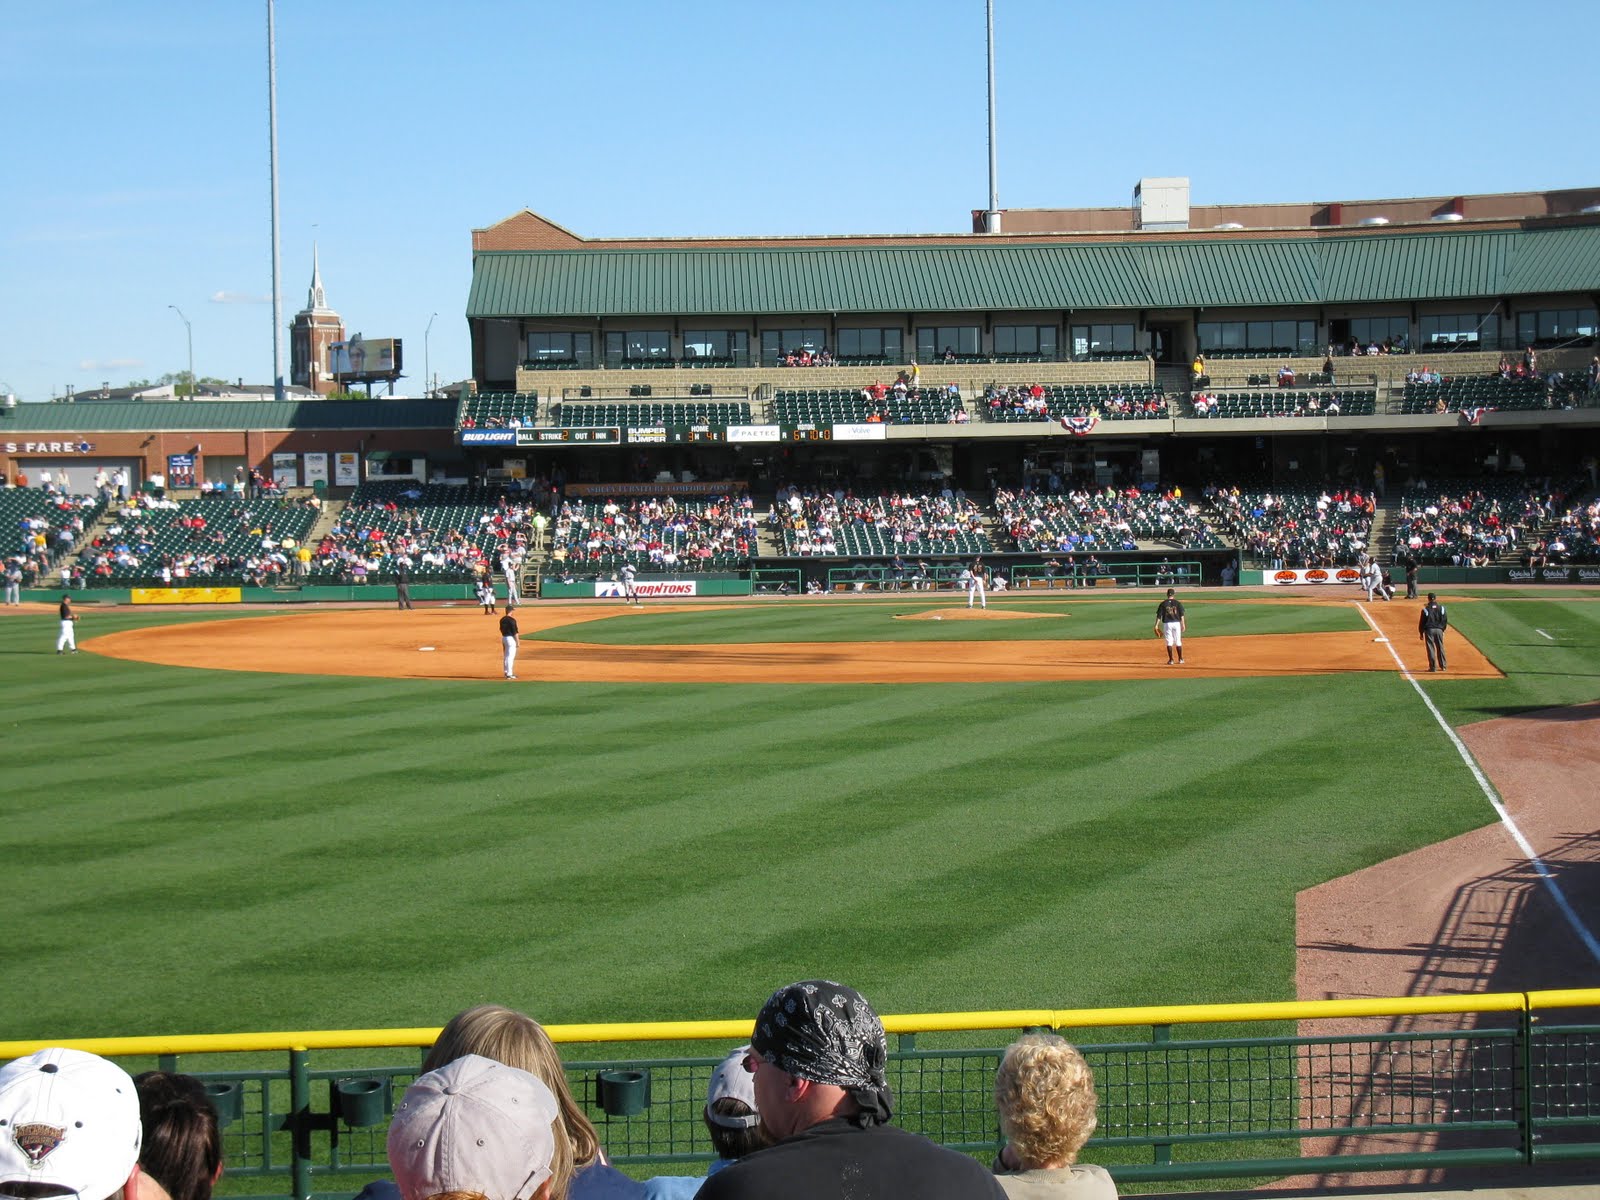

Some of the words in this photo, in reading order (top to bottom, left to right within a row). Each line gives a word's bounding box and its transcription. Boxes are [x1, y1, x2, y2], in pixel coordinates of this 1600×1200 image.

[463, 433, 485, 441] BUD
[485, 432, 514, 440] LIGHT
[518, 433, 533, 441] BALL
[541, 432, 562, 440] STRIKE
[562, 430, 569, 441] 2
[575, 432, 588, 440] OUT
[595, 432, 607, 440] INN
[675, 433, 681, 441] R
[713, 432, 718, 440] E
[782, 431, 787, 439] R
[25, 442, 74, 453] FARE
